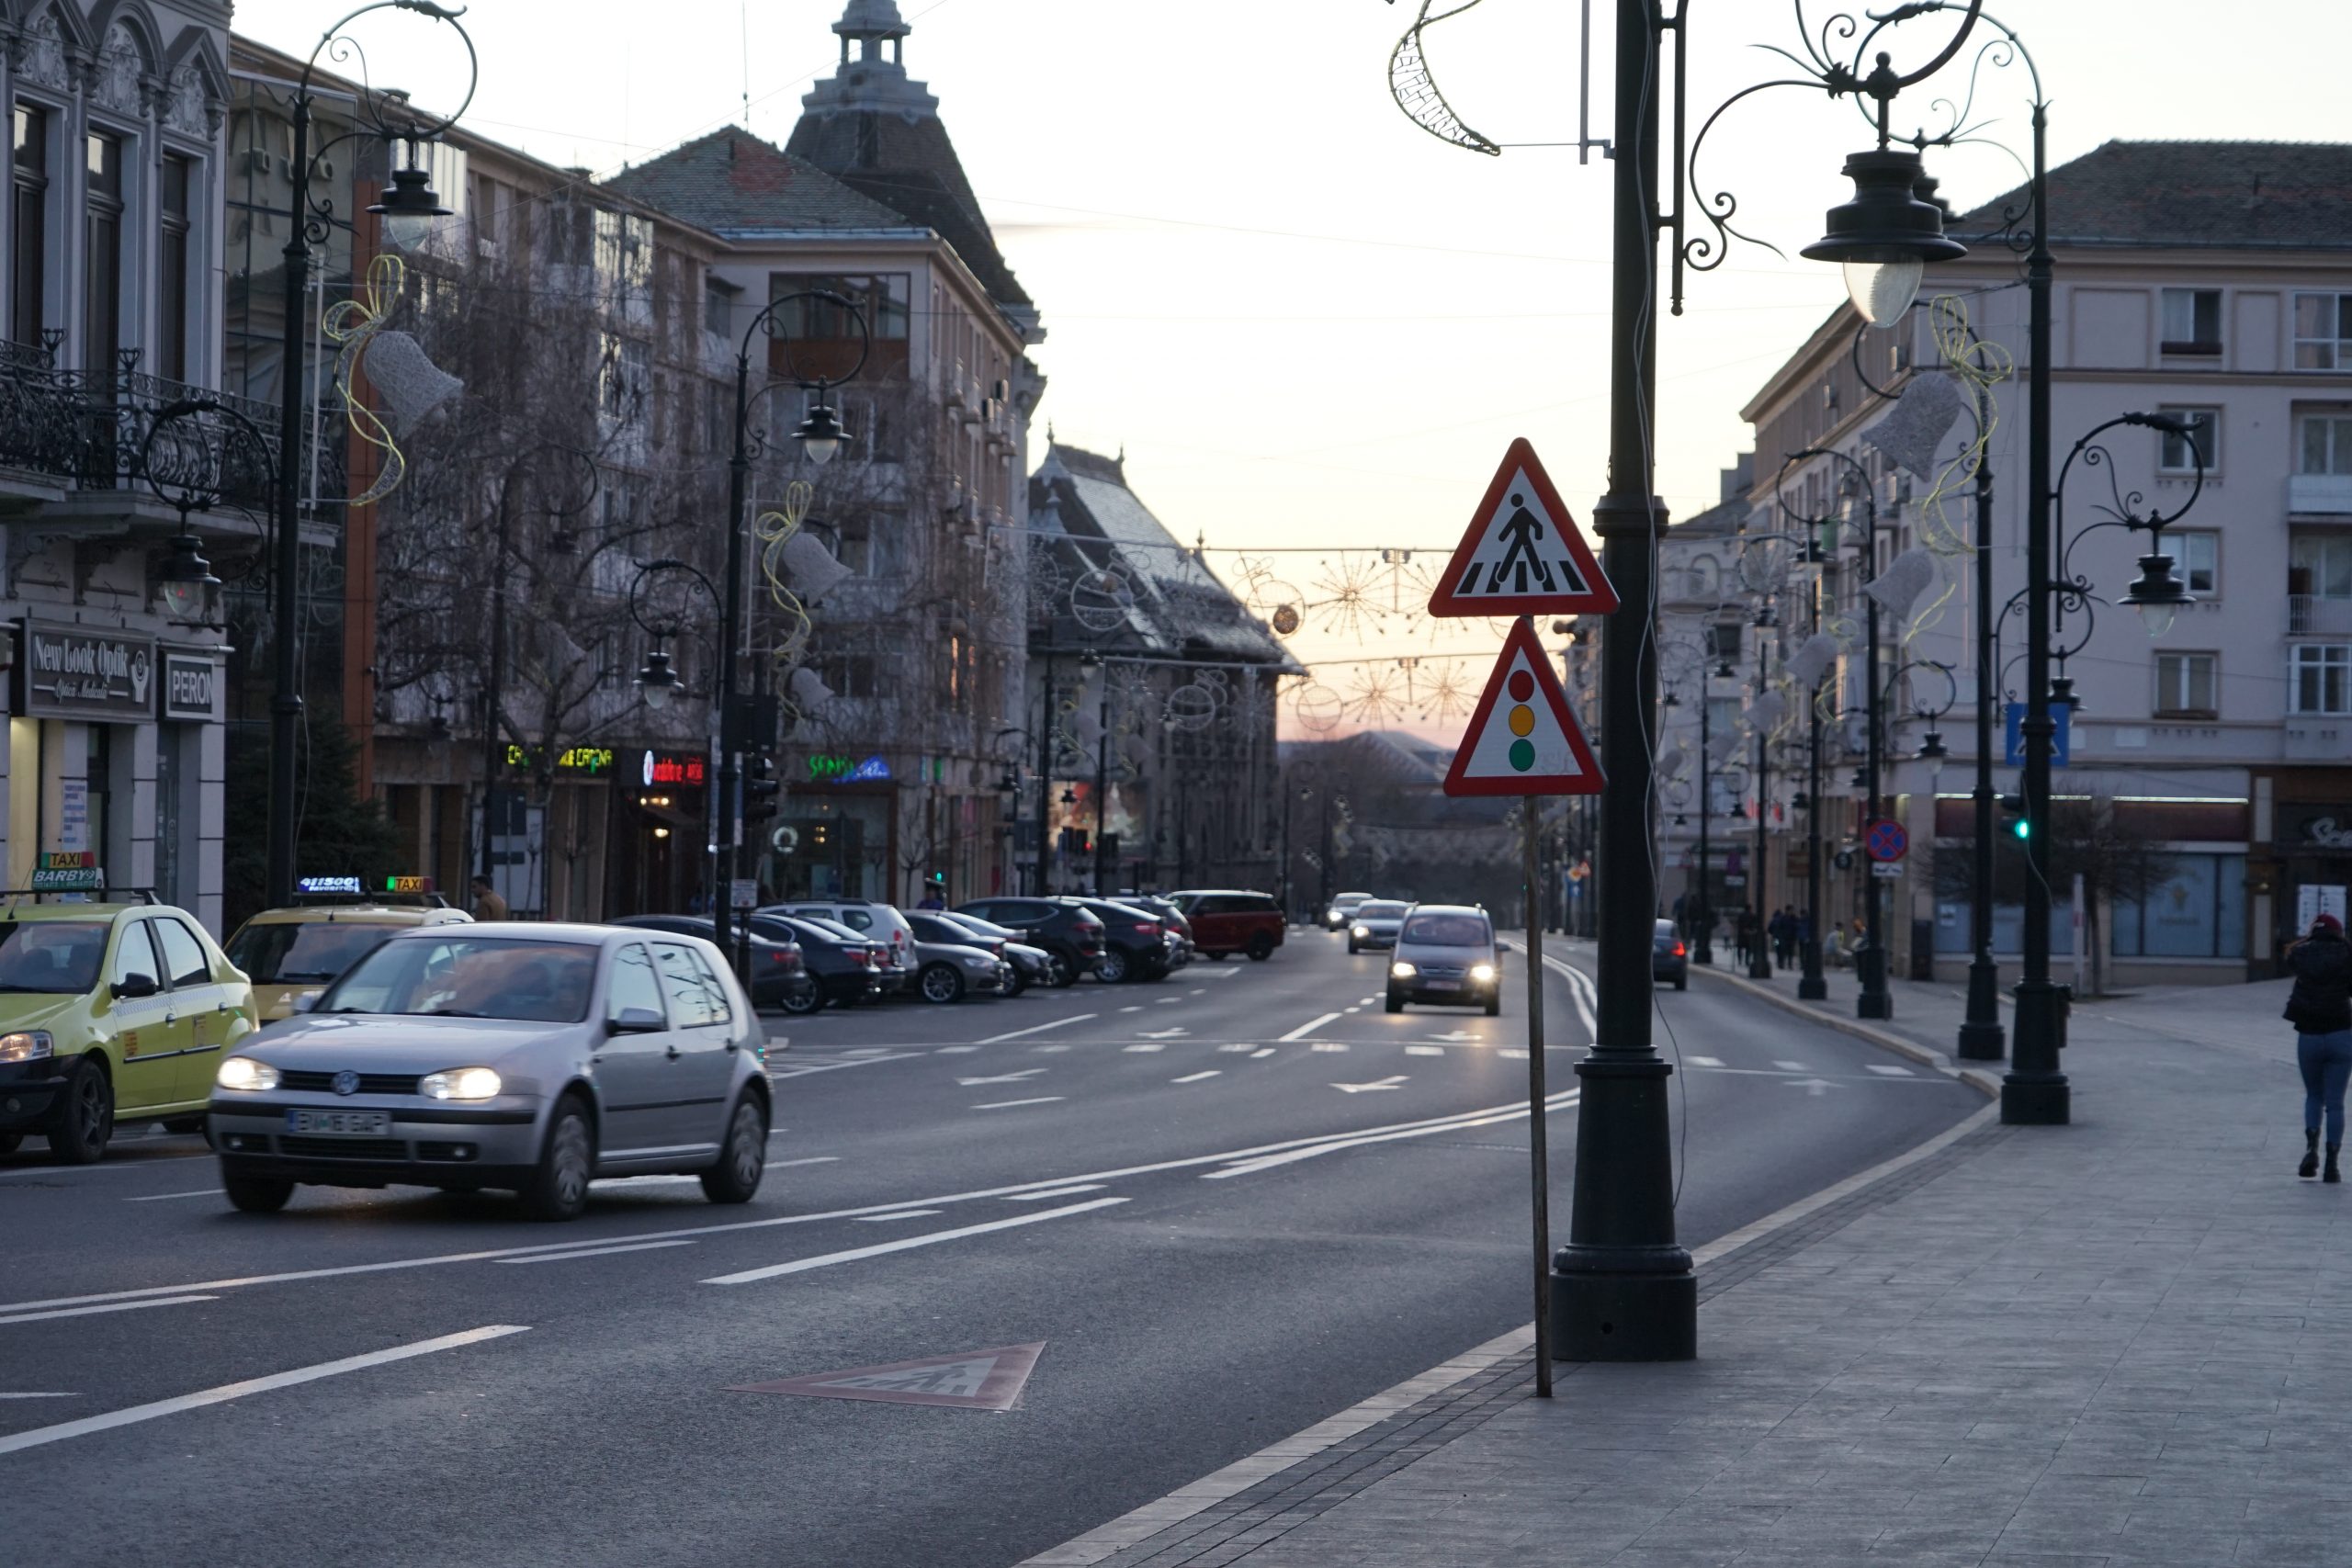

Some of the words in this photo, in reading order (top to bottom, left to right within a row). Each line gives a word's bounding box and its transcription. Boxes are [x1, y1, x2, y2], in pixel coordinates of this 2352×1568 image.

[33, 636, 62, 671] New
[64, 638, 95, 675] Look
[97, 641, 128, 683] Optik
[51, 852, 82, 866] TAXI
[34, 870, 88, 882] BARBY
[300, 877, 355, 887] 411500
[396, 878, 423, 890] TAXI
